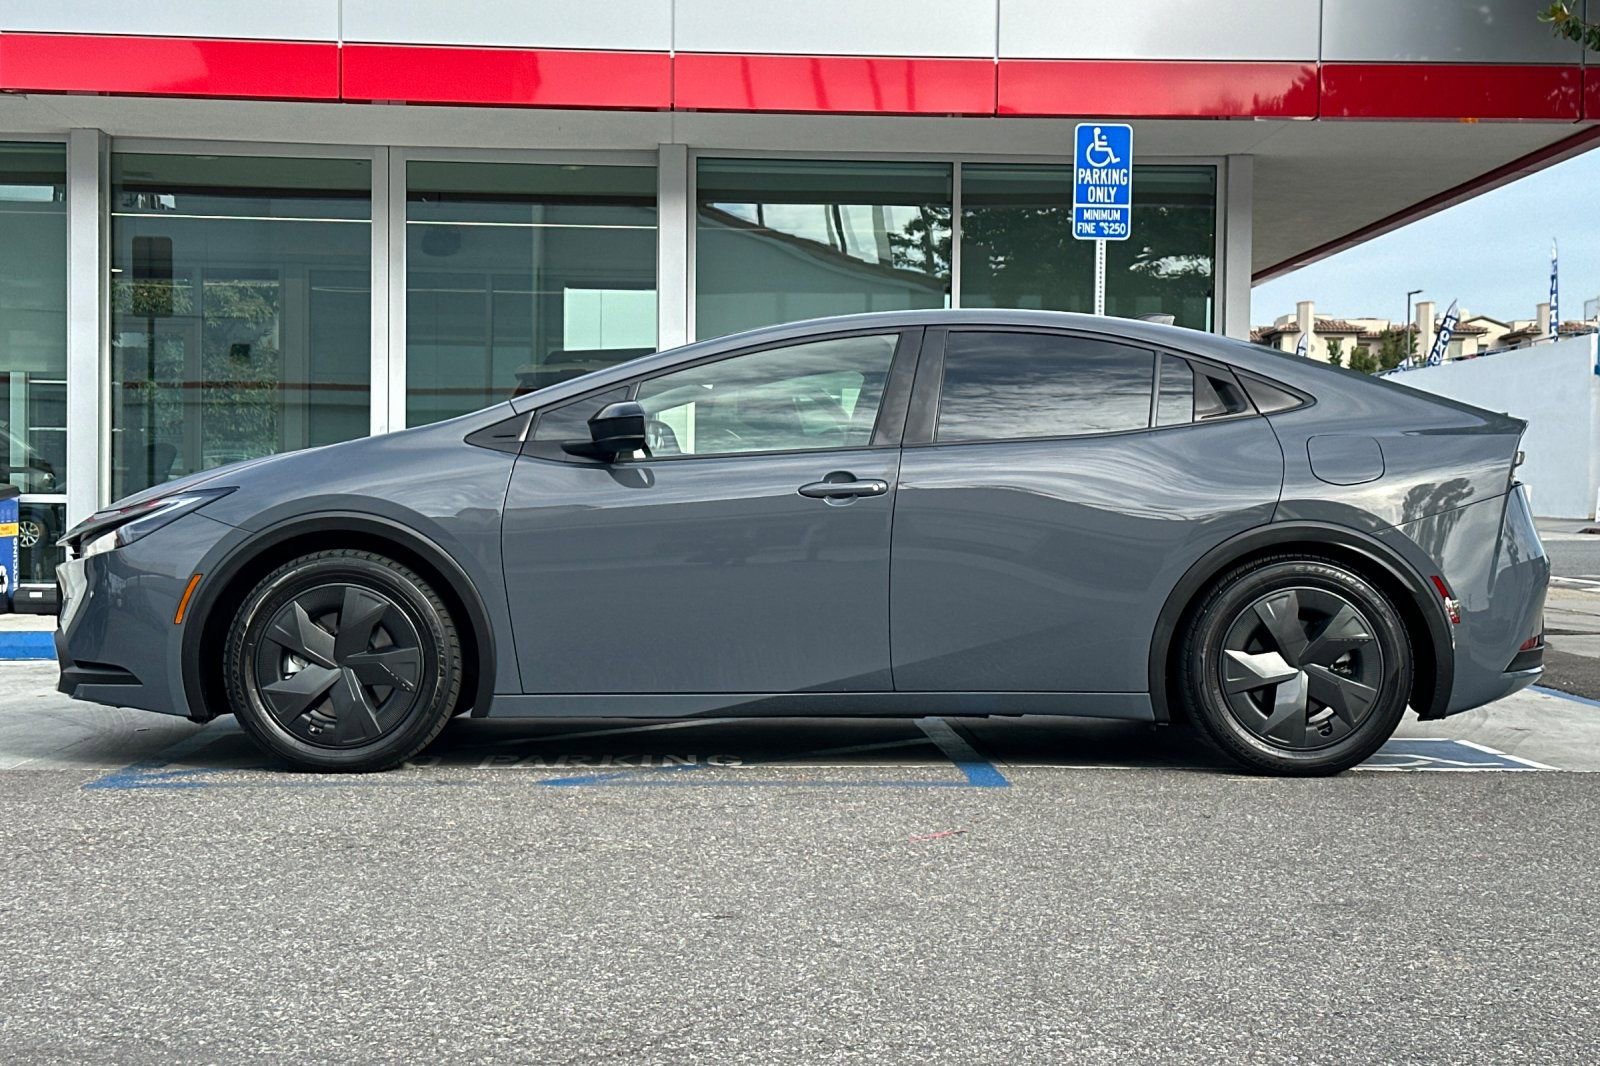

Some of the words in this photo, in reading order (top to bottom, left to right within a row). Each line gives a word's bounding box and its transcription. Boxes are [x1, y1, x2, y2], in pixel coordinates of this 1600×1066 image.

[1078, 168, 1128, 185] PARKING
[1087, 186, 1117, 203] ONLY
[1083, 209, 1121, 221] MINIMUM
[1077, 222, 1096, 234] FINE
[1103, 223, 1126, 235] $250
[1294, 566, 1365, 591] EXTENSA
[477, 754, 743, 768] PARKING
